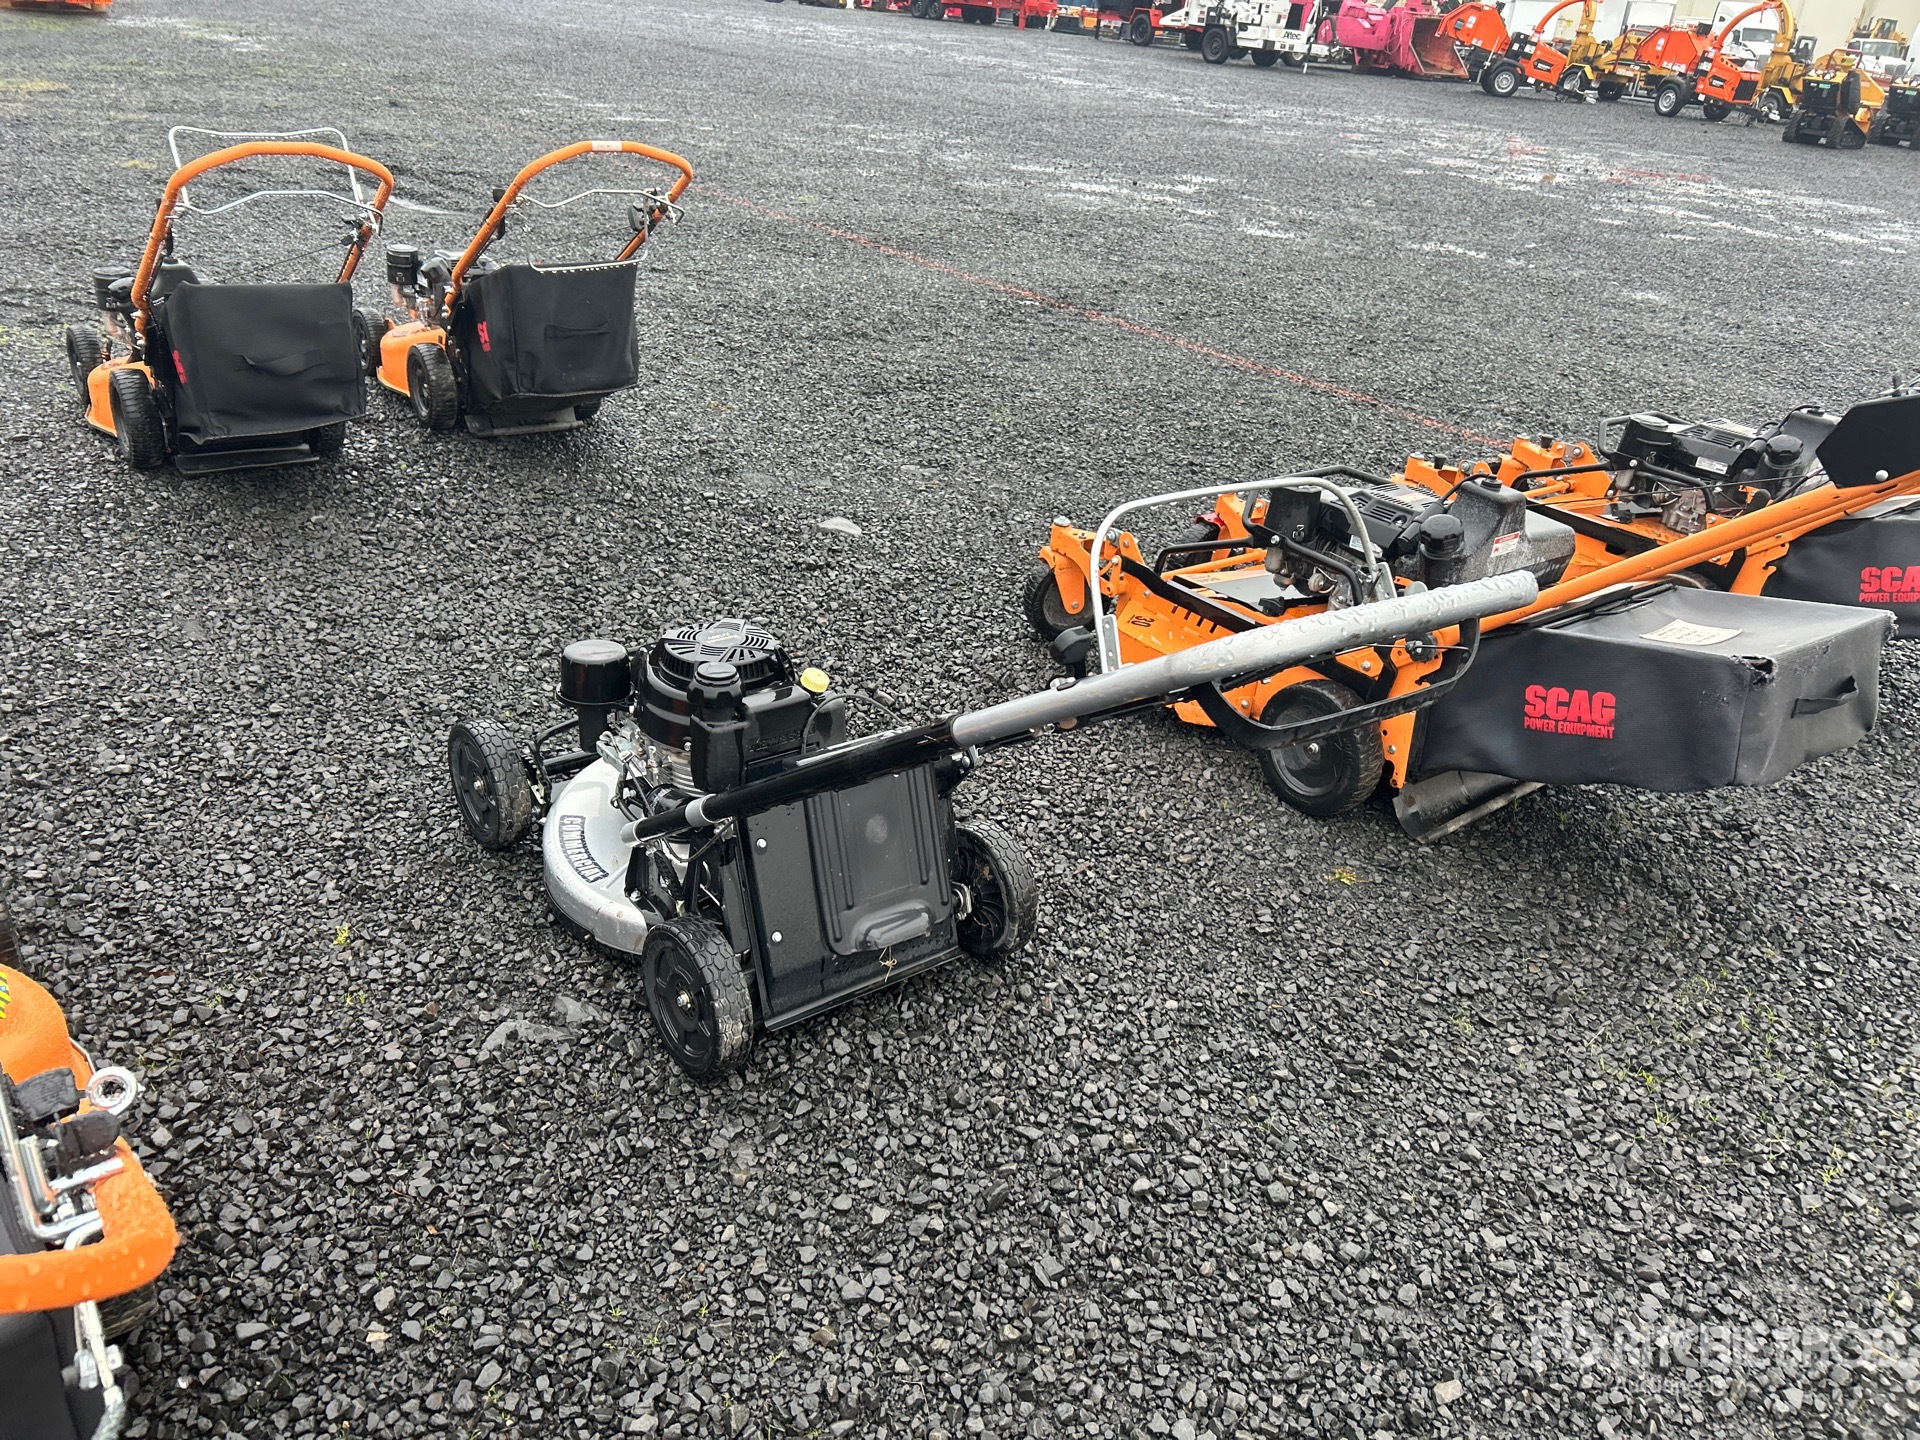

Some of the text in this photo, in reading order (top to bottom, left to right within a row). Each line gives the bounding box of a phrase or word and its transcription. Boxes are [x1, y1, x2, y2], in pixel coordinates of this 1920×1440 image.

[1282, 30, 1302, 41] Altec
[1858, 592, 1890, 603] POWER
[1524, 684, 1617, 725] SCAG
[1523, 716, 1615, 740] POWER EQUIPMENT
[561, 816, 606, 883] COMMERCIAL
